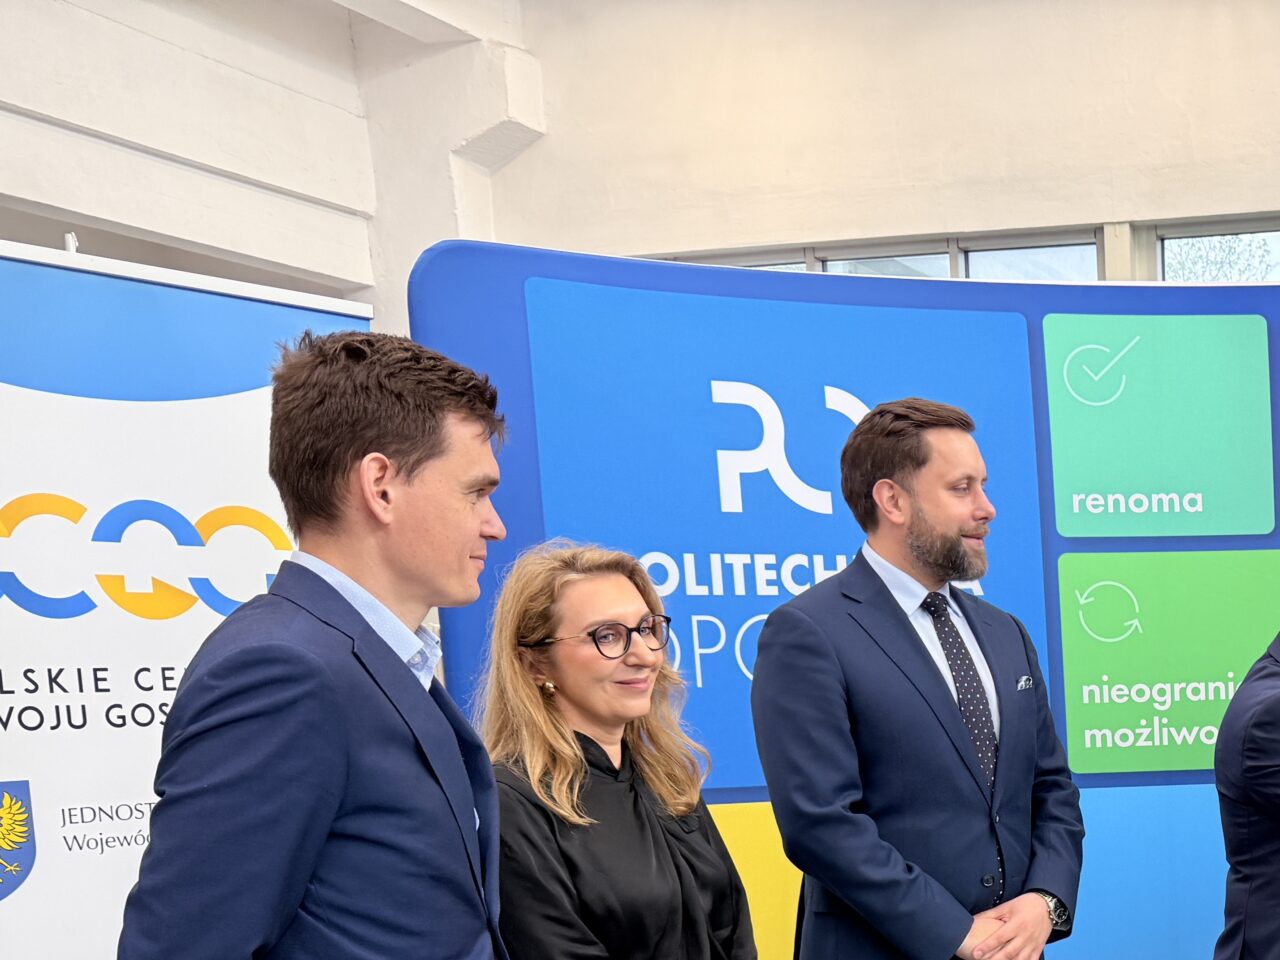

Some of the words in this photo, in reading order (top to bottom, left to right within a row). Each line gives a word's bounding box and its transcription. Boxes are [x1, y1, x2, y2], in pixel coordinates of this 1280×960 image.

[1072, 490, 1203, 514] renoma
[634, 551, 860, 597] OLITECH
[134, 666, 188, 691] CE
[1081, 672, 1243, 711] nieograni
[1084, 716, 1219, 749] możliwo
